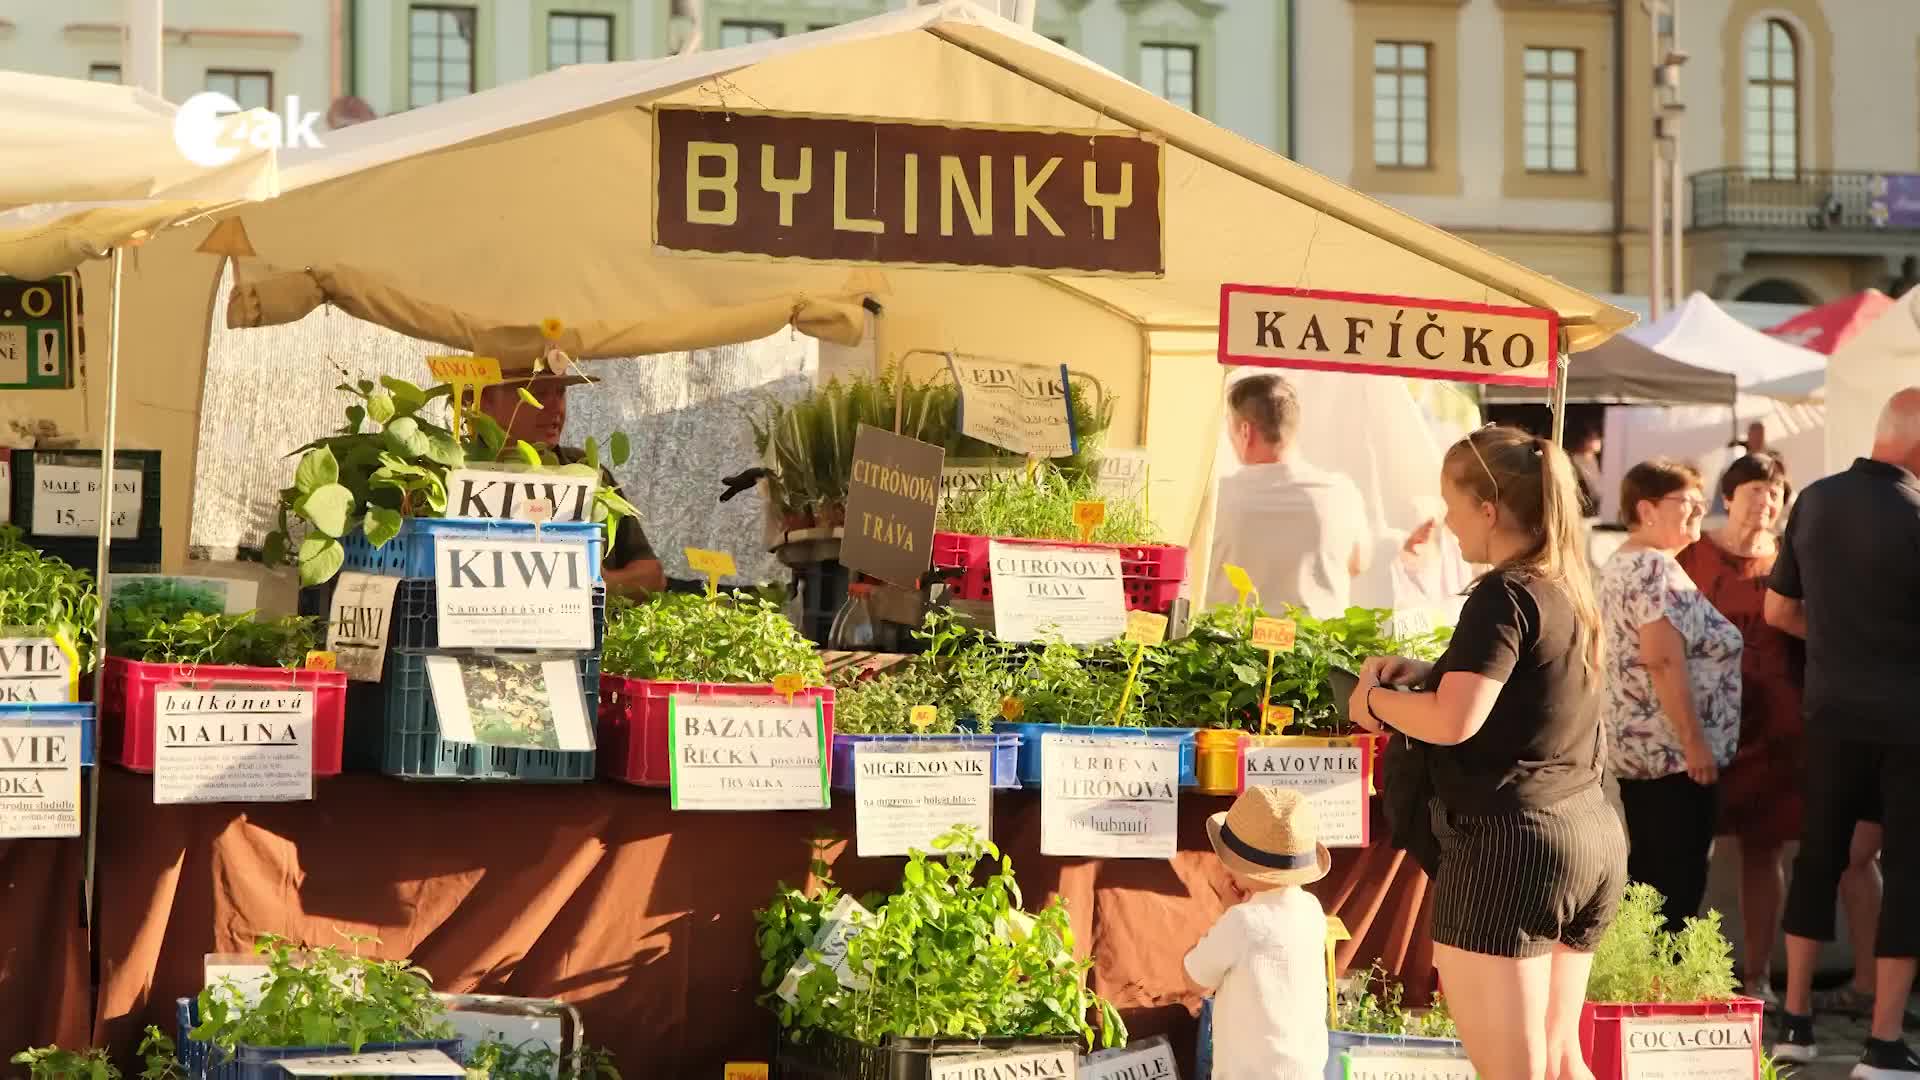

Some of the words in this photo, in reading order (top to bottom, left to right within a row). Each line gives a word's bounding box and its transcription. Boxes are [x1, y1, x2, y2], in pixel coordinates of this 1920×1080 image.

[686, 140, 1133, 241] BYLINKY
[1254, 309, 1535, 368] KAFÍČKO
[88, 480, 135, 493] BAENÍ
[853, 459, 935, 506] CITRÓNOVÁ
[458, 479, 588, 522] KIWI
[863, 511, 914, 552] TRÁVA
[448, 549, 582, 590] KIWI
[338, 605, 384, 640] KIWI
[166, 723, 298, 743] MALINA
[685, 717, 813, 738] BAZALKA
[2, 735, 68, 763] VIE
[684, 744, 759, 765] ŘECKÁ
[1062, 756, 1159, 773] ERBENA
[1246, 754, 1359, 772] KÁVOVNÍK
[1058, 775, 1174, 799] ITRÓNOVÁ
[1090, 814, 1152, 833] hubnutí
[1628, 1028, 1752, 1048] COCA-COLA
